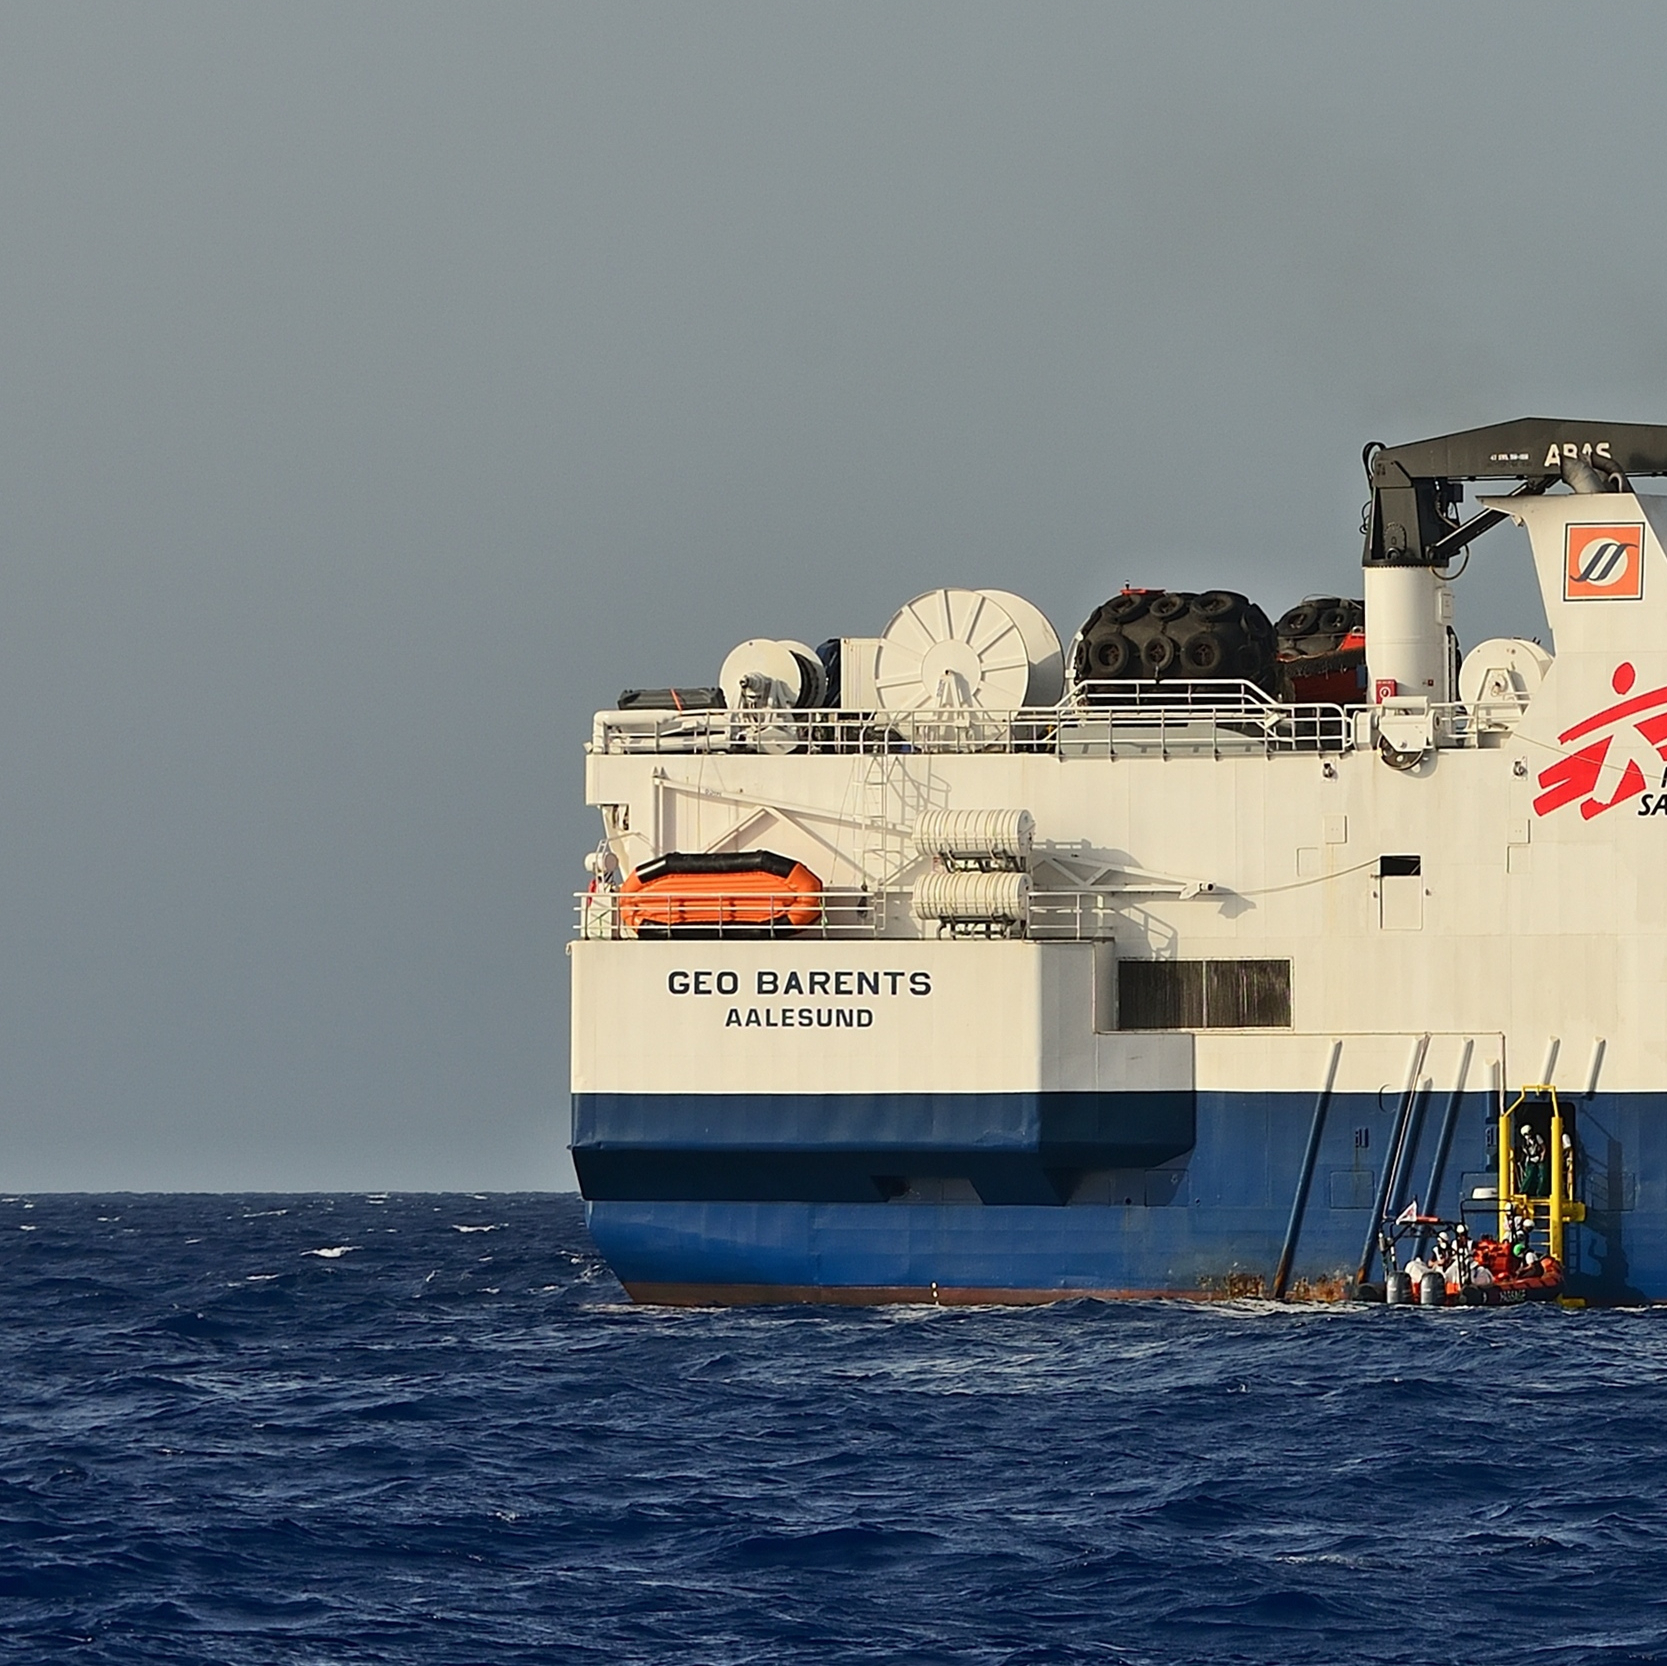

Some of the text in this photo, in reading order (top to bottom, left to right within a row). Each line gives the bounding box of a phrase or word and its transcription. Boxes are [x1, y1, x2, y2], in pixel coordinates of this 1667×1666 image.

[668, 971, 932, 996] GEO BARENTS
[725, 1008, 873, 1028] AALESUND
